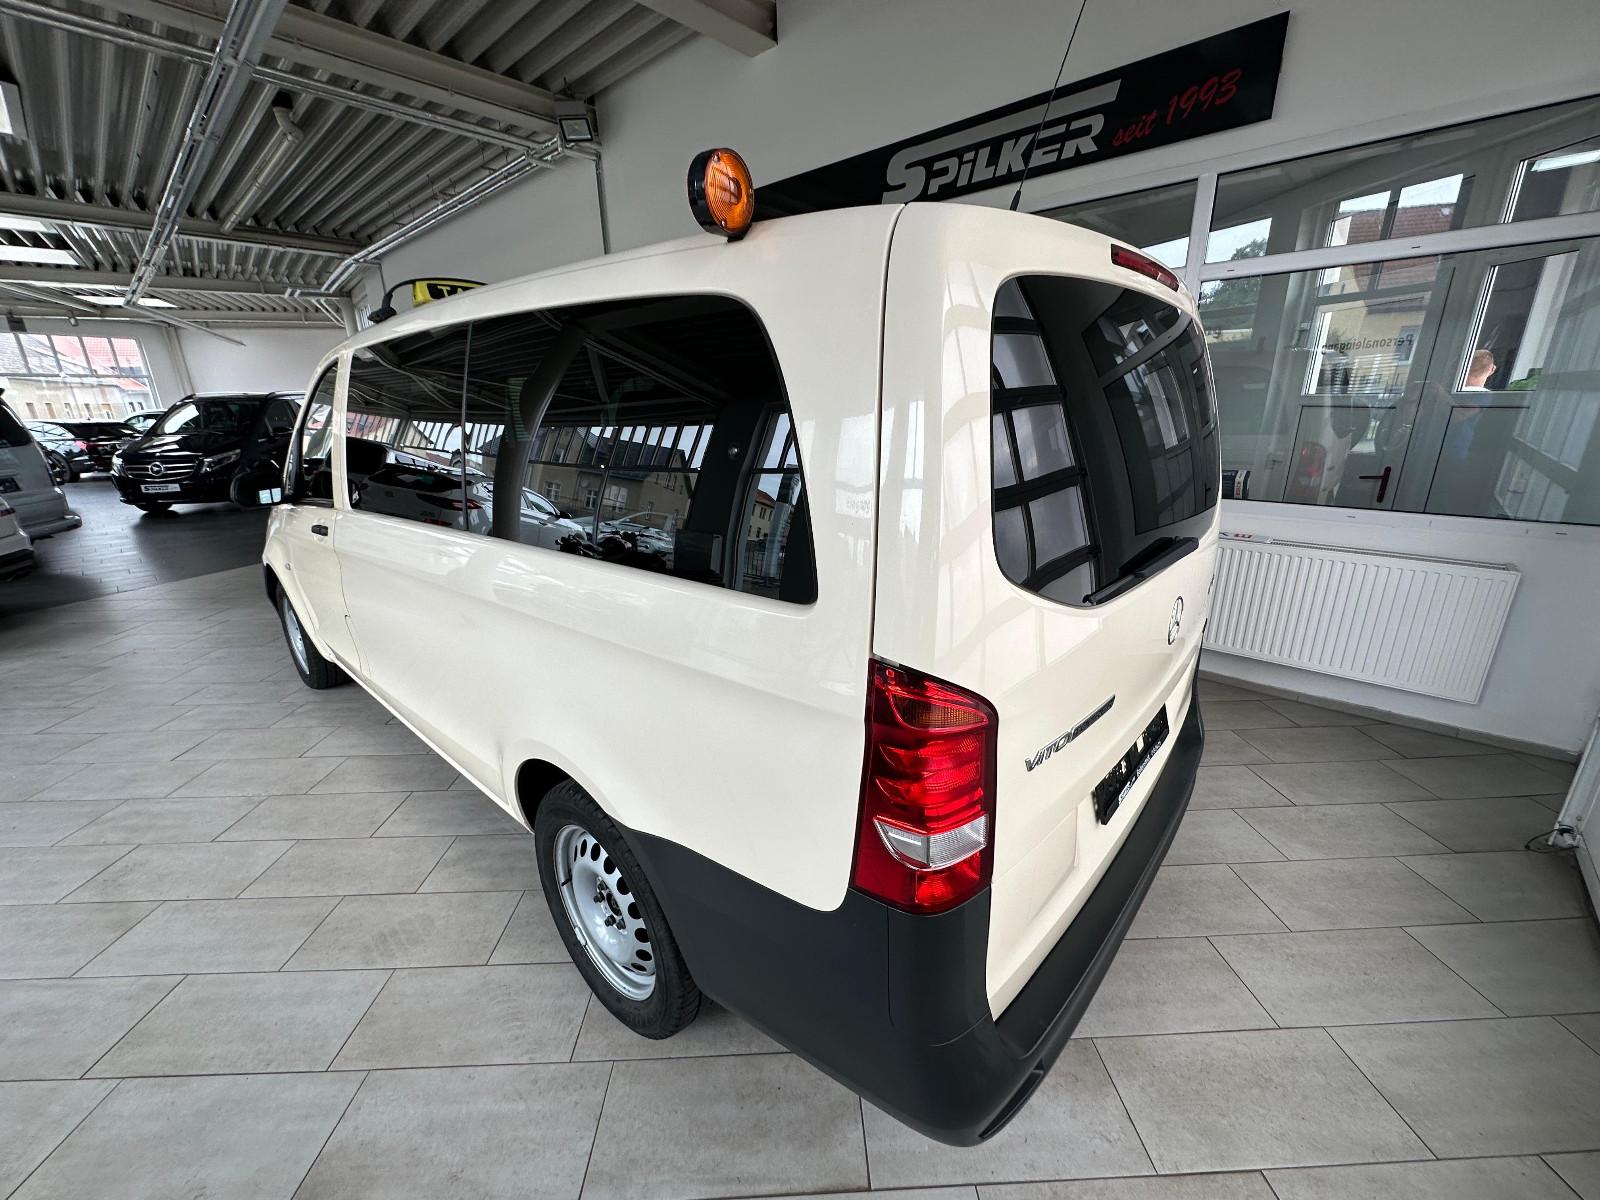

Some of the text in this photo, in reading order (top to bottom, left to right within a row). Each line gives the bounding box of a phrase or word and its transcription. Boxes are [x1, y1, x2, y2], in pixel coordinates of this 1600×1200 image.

[1112, 109, 1158, 147] seit
[1166, 68, 1243, 125] 1993
[1024, 730, 1072, 772] VITO
